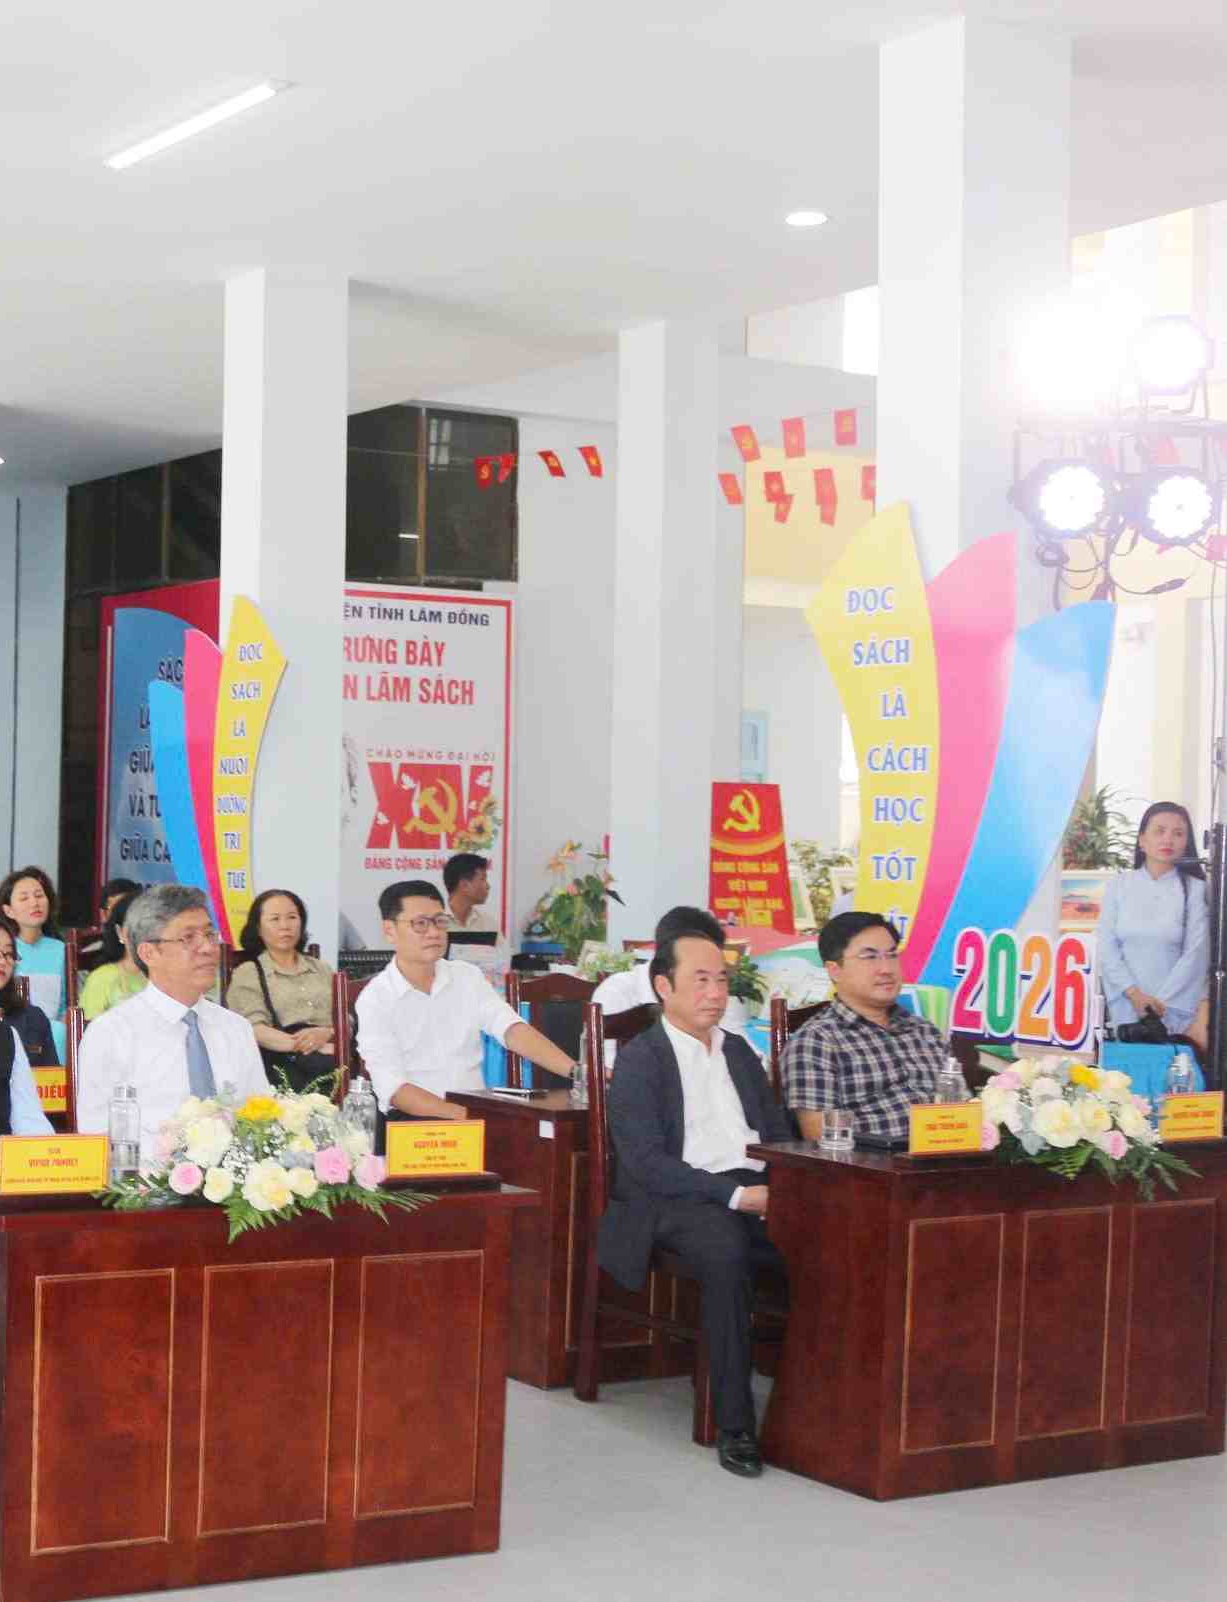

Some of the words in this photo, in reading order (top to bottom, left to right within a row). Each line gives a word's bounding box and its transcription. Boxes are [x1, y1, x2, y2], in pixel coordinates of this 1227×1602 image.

[409, 608, 442, 624] LÂM
[447, 608, 490, 626] ĐỒNG
[343, 634, 397, 665] RƯNG
[405, 634, 446, 667] BÀY
[853, 634, 910, 665] SÁCH
[366, 672, 411, 702] LÃM
[419, 674, 474, 705] SÁCH
[882, 687, 907, 718] LÀ
[867, 740, 928, 772] CÁCH
[874, 797, 924, 827] HỌC
[871, 848, 917, 881] TỐT
[951, 929, 1088, 1043] 2026
